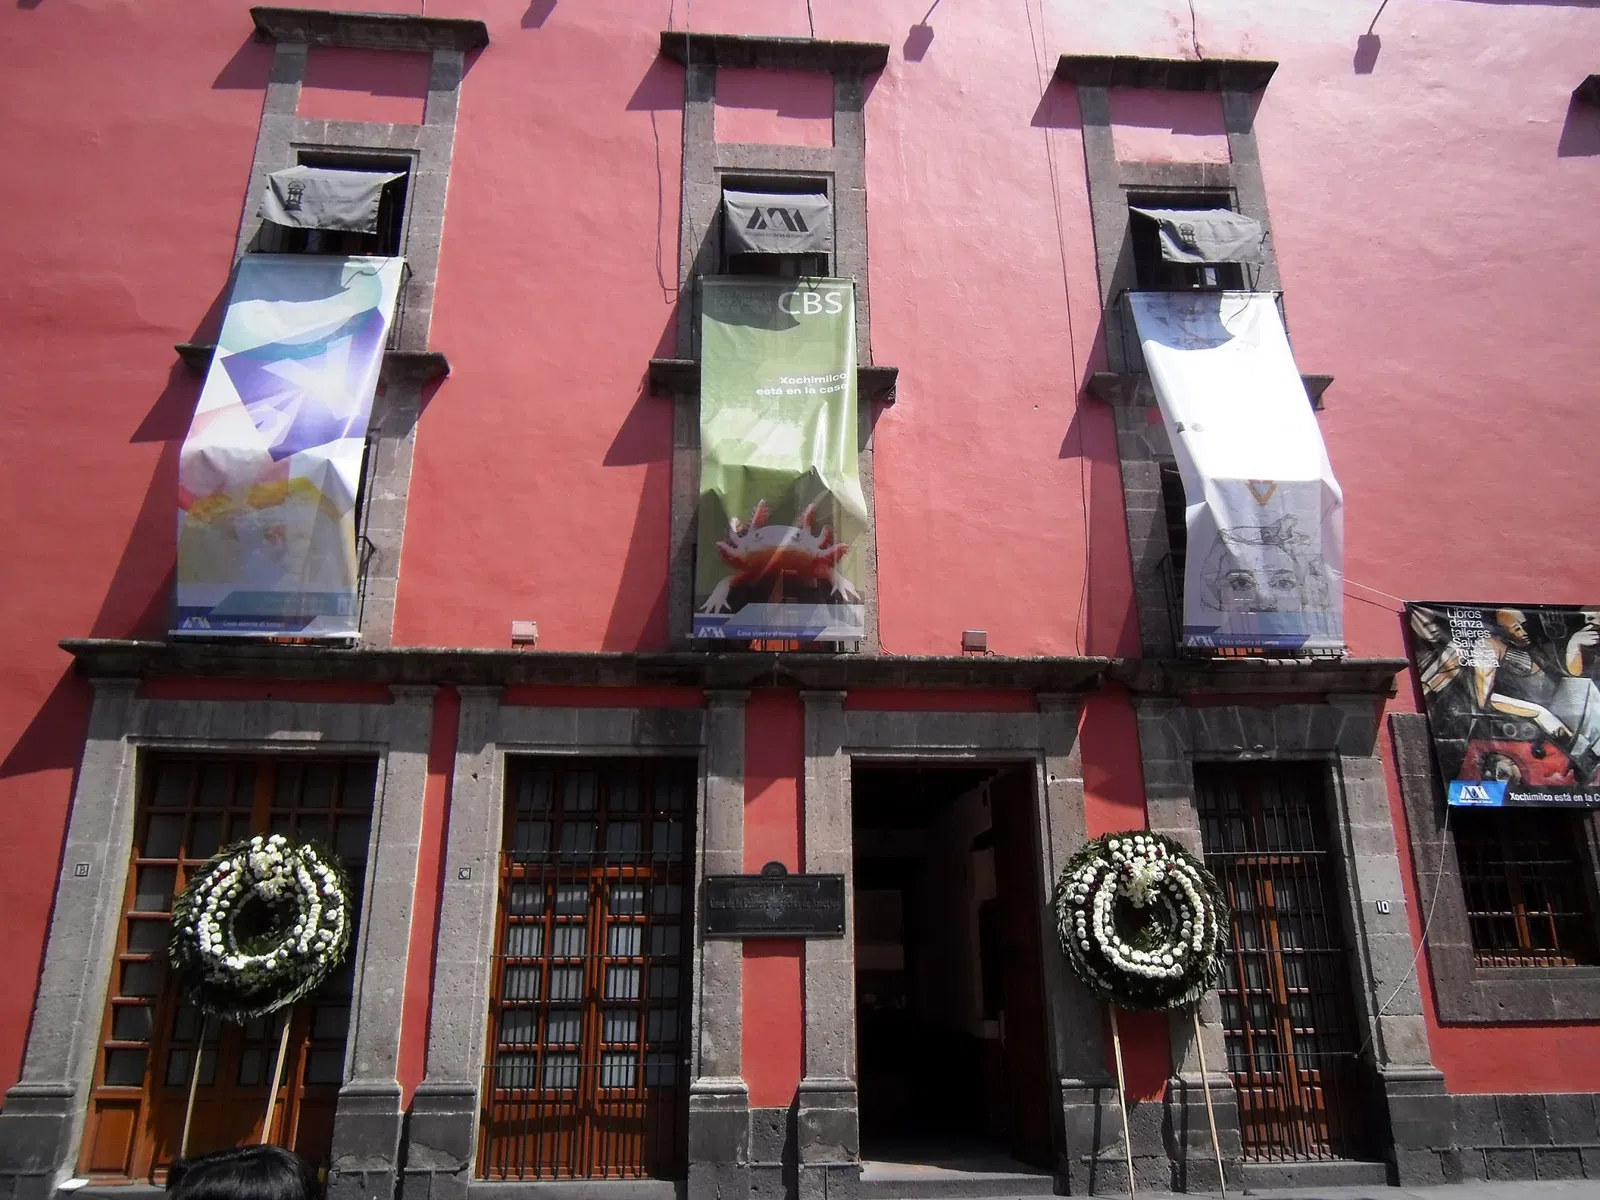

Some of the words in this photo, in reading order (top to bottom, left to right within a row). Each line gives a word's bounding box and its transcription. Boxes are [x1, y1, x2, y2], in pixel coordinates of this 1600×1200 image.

[778, 291, 843, 315] CBS
[780, 372, 847, 385] Xochimilco
[756, 387, 783, 396] está
[805, 387, 817, 395] la
[1447, 607, 1482, 619] Libros
[1449, 616, 1484, 628] danza
[1451, 627, 1491, 639] talleres
[1452, 637, 1486, 649] Salud
[1509, 792, 1553, 801] Xochimilco
[1554, 792, 1572, 802] está
[1573, 794, 1583, 802] en
[1584, 793, 1593, 802] la
[1376, 900, 1390, 914] 10
